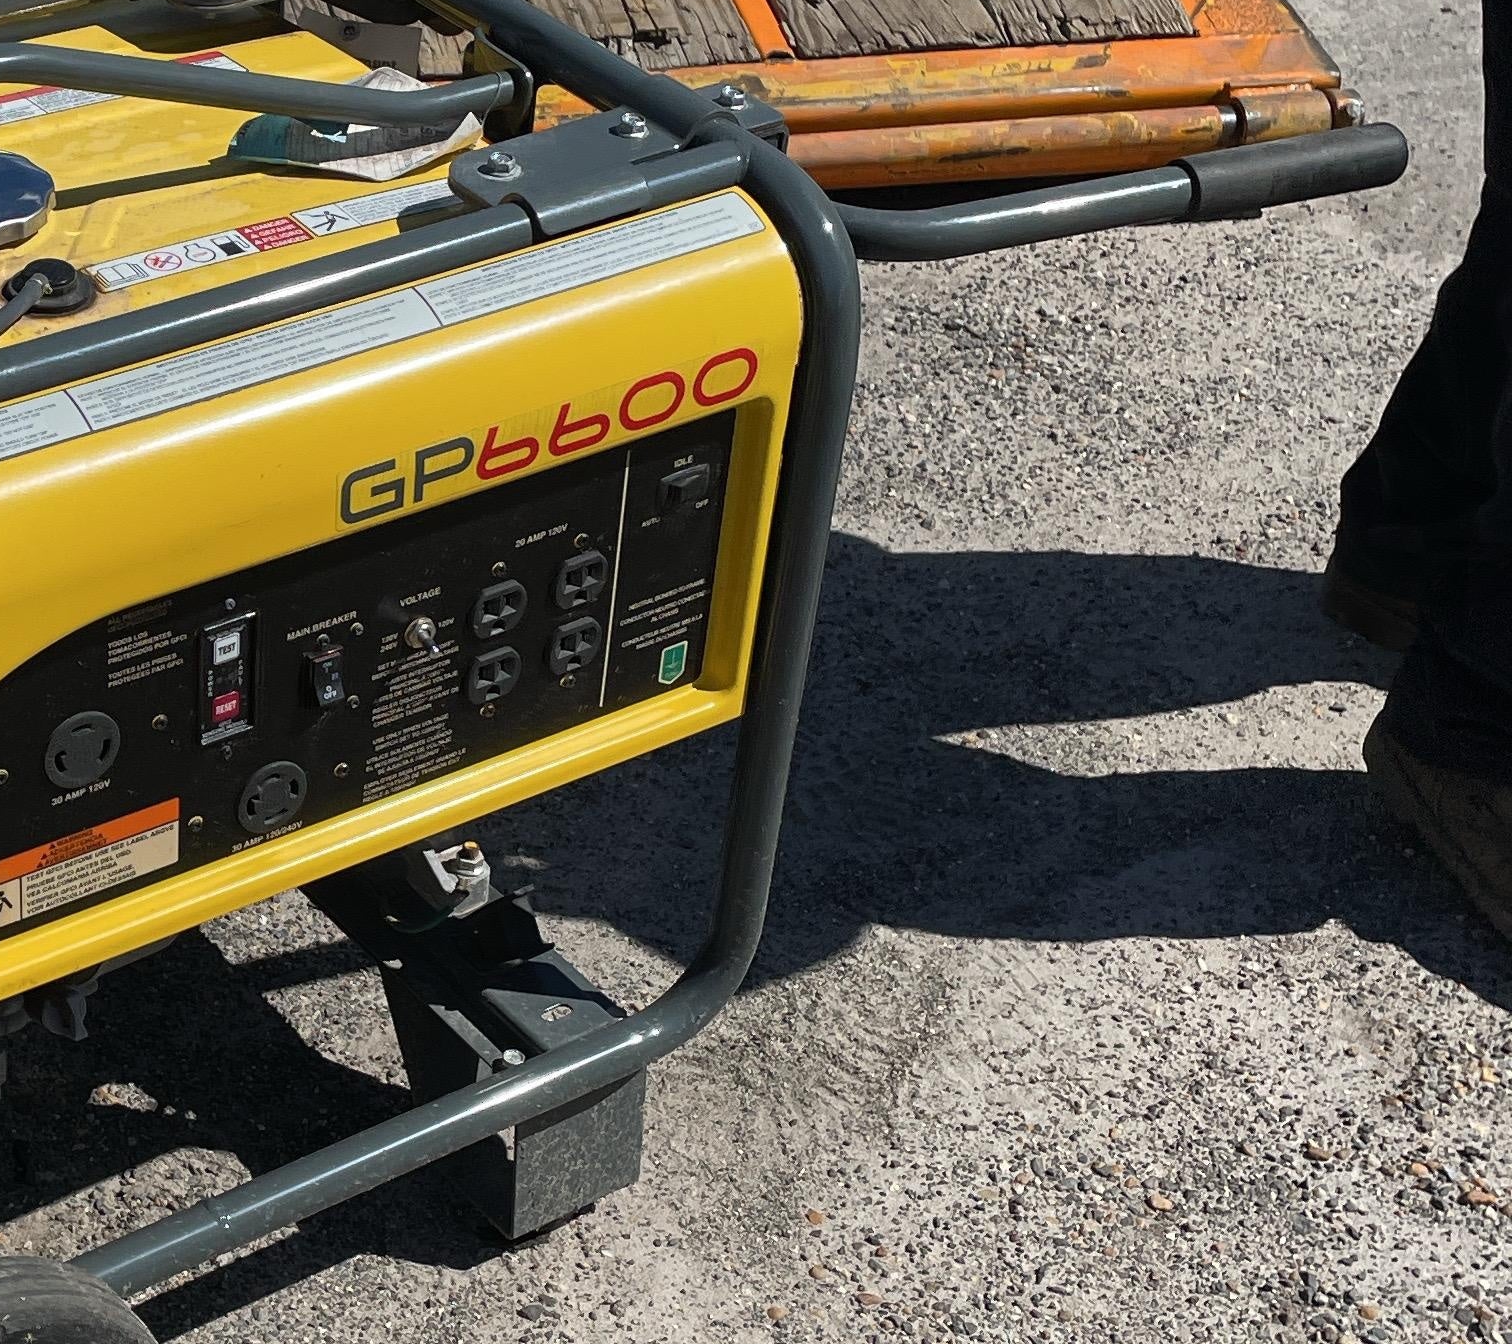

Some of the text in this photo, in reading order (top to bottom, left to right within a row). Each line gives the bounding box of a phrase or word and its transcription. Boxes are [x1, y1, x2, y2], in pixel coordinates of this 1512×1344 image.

[339, 346, 759, 525] GP6600
[674, 454, 694, 468] IDLE
[515, 538, 526, 547] 20
[526, 530, 546, 544] AMP
[399, 586, 441, 606] VOLTAGE
[287, 610, 358, 642] MAIN BREAKER
[217, 642, 236, 656] TEST
[323, 690, 337, 700] OFF
[215, 699, 237, 715] RESET
[51, 778, 111, 806] 30 AMP 120V
[243, 836, 264, 848] AMP
[26, 871, 44, 883] TEST
[64, 854, 93, 871] BEFORE
[94, 847, 110, 861] USE
[110, 842, 125, 853] SEE
[125, 833, 149, 849] LABEL
[150, 823, 175, 840] ABOVE
